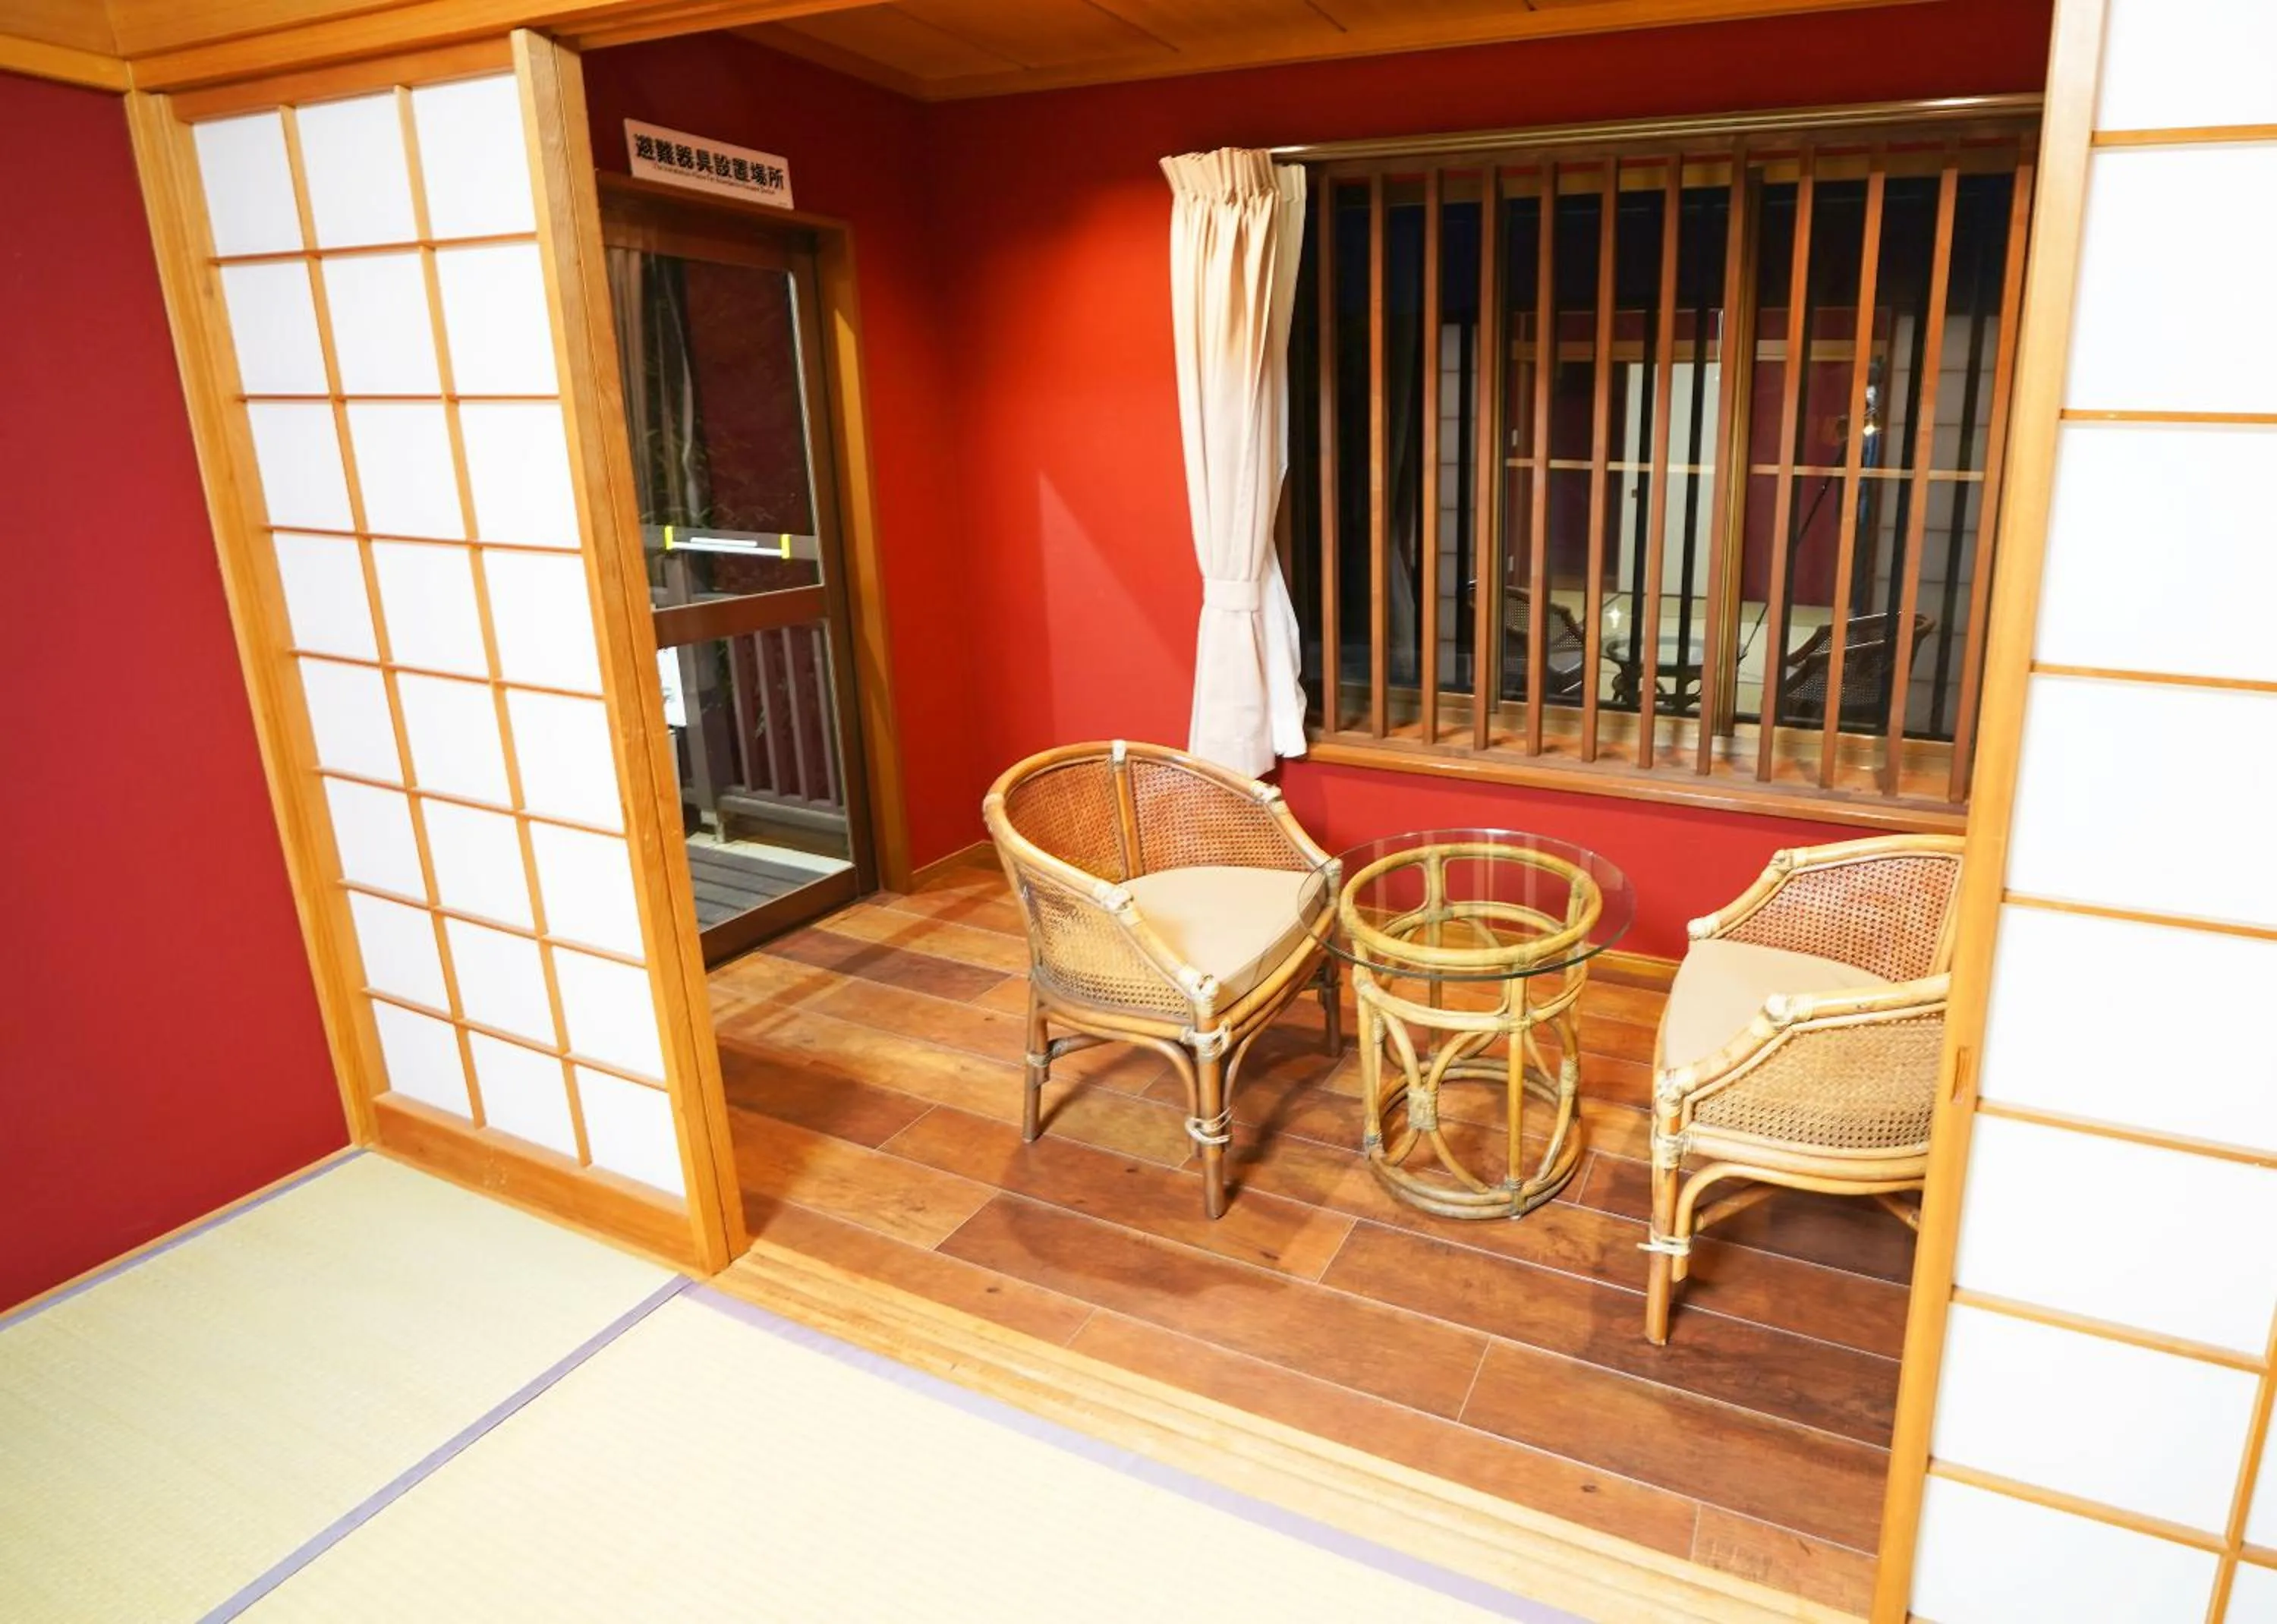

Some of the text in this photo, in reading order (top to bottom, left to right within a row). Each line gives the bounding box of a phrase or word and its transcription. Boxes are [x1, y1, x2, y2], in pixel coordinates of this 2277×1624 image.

[634, 134, 784, 190] 避難器具設置場所
